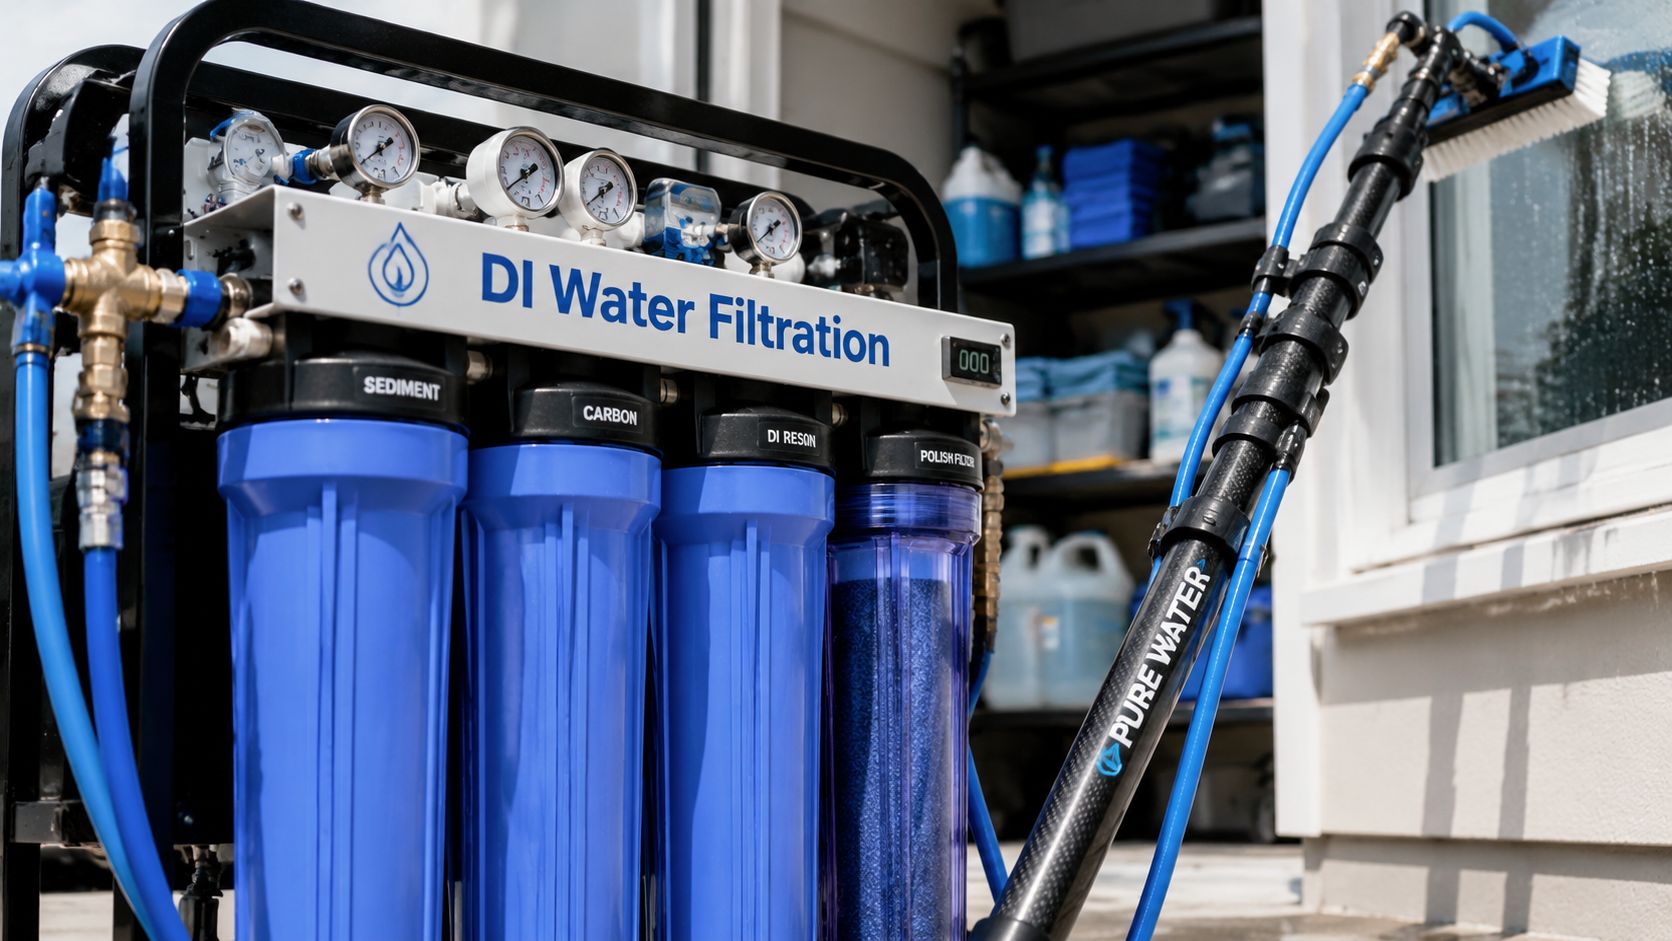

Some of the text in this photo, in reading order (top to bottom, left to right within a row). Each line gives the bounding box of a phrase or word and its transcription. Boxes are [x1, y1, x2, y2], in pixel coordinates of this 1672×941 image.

[482, 252, 890, 367] DI Water Filtration
[959, 348, 989, 374] 000
[363, 376, 441, 402] SEDIMENT
[583, 405, 638, 426] CARBON
[767, 429, 780, 443] DI
[920, 449, 954, 465] POLISH
[1109, 566, 1211, 749] PURE WATER
